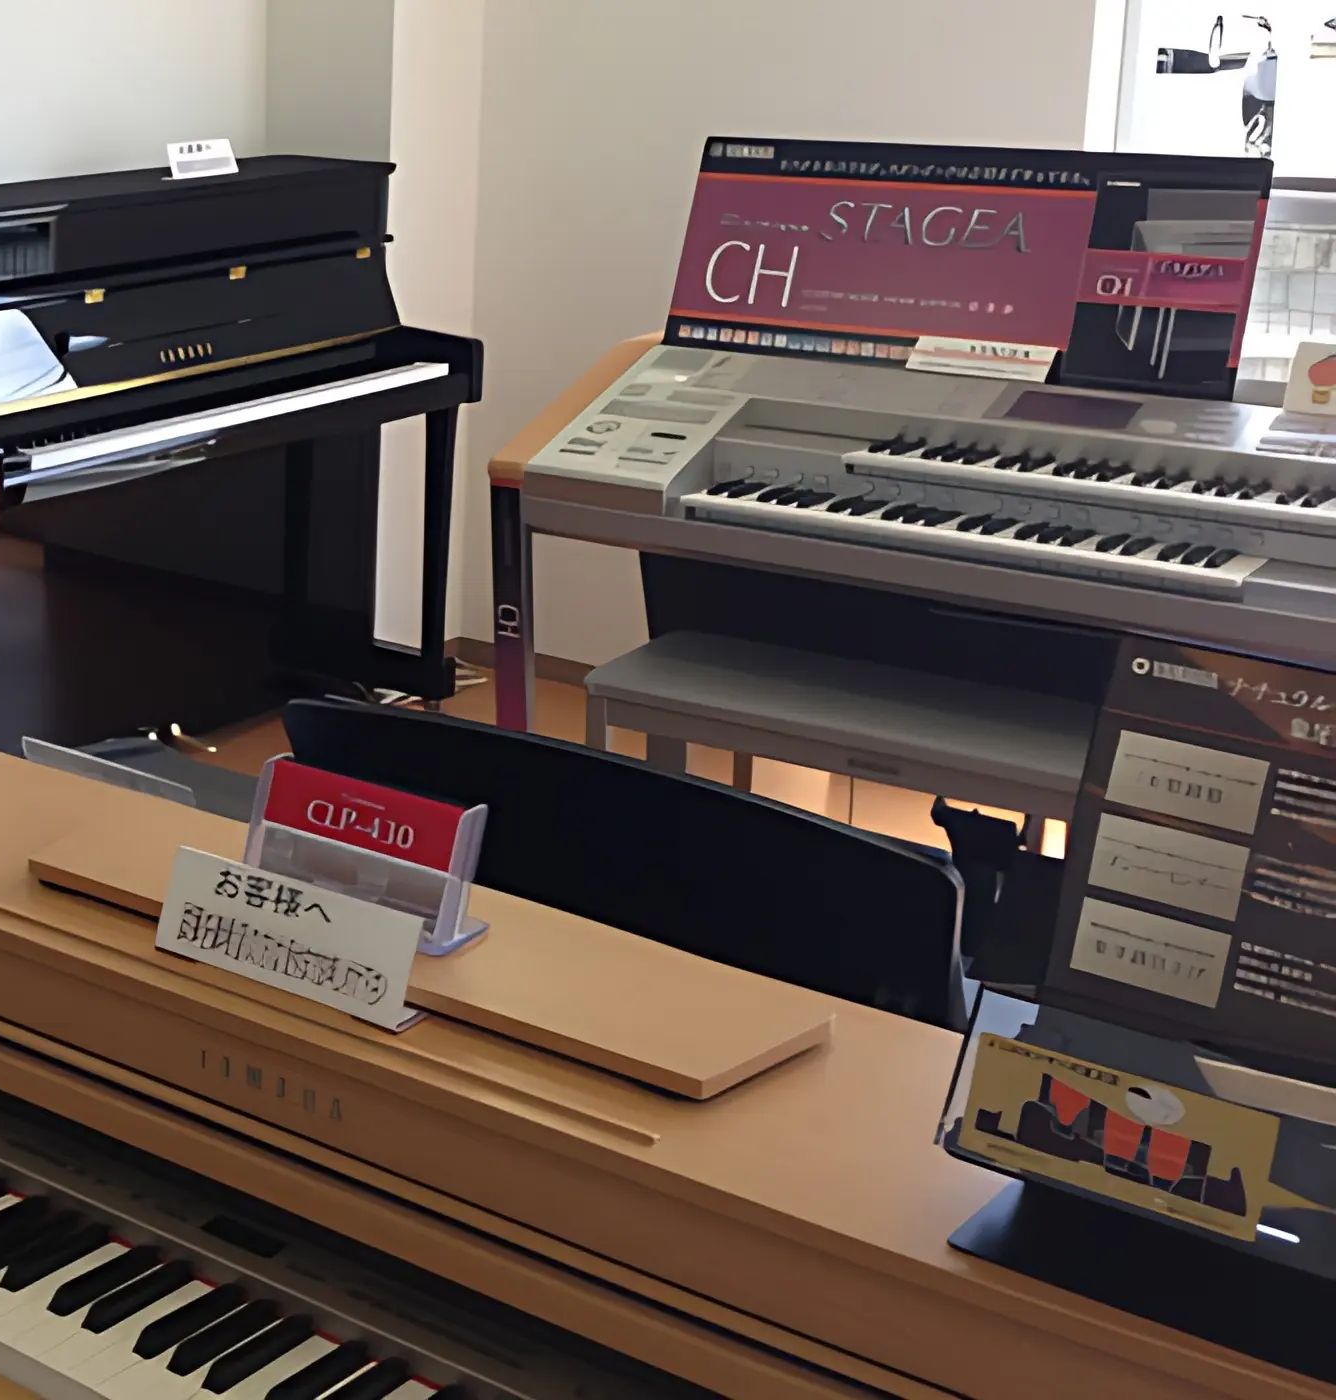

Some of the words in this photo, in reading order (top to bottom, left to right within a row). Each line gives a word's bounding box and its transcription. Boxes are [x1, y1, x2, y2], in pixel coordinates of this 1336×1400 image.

[819, 199, 1031, 253] STAGEA
[705, 240, 799, 308] CH
[214, 870, 332, 924] お客様へ
